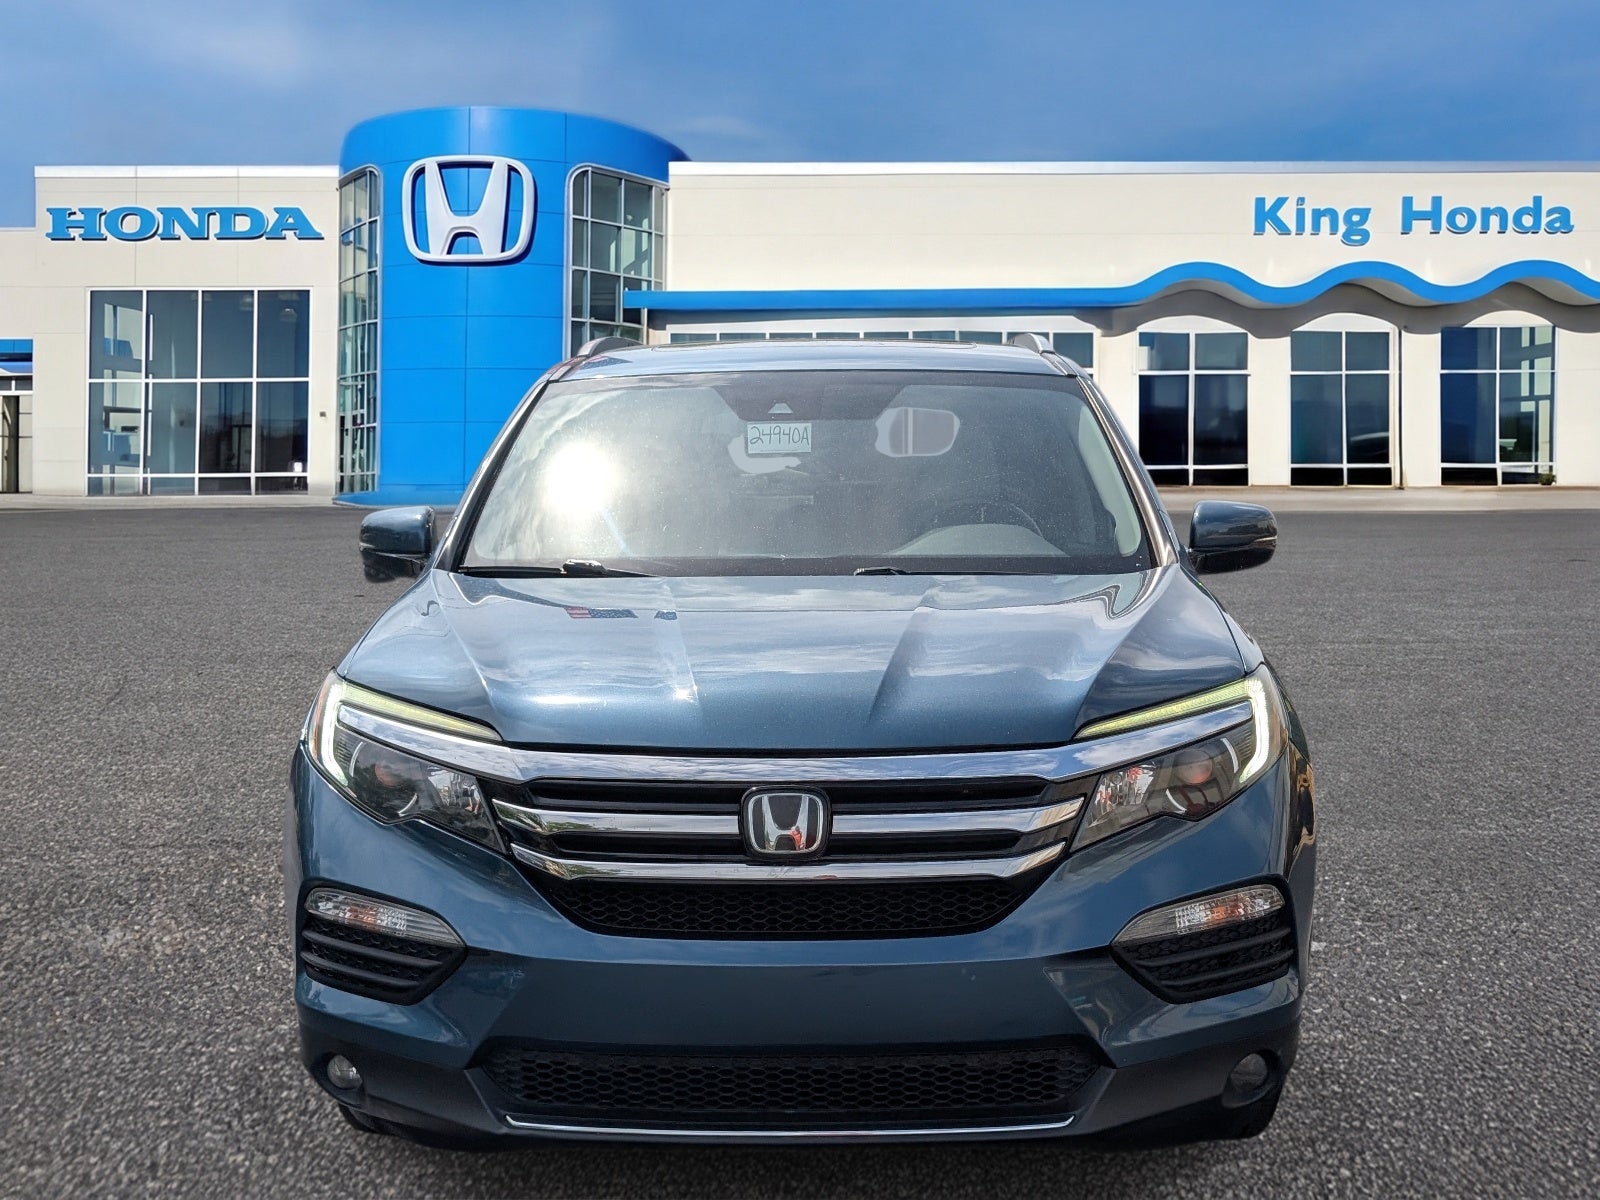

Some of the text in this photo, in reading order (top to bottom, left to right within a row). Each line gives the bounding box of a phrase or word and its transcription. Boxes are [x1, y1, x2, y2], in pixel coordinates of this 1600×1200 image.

[45, 206, 324, 241] HONDA
[1253, 195, 1575, 246] King Honda
[749, 425, 810, 446] 24940A
